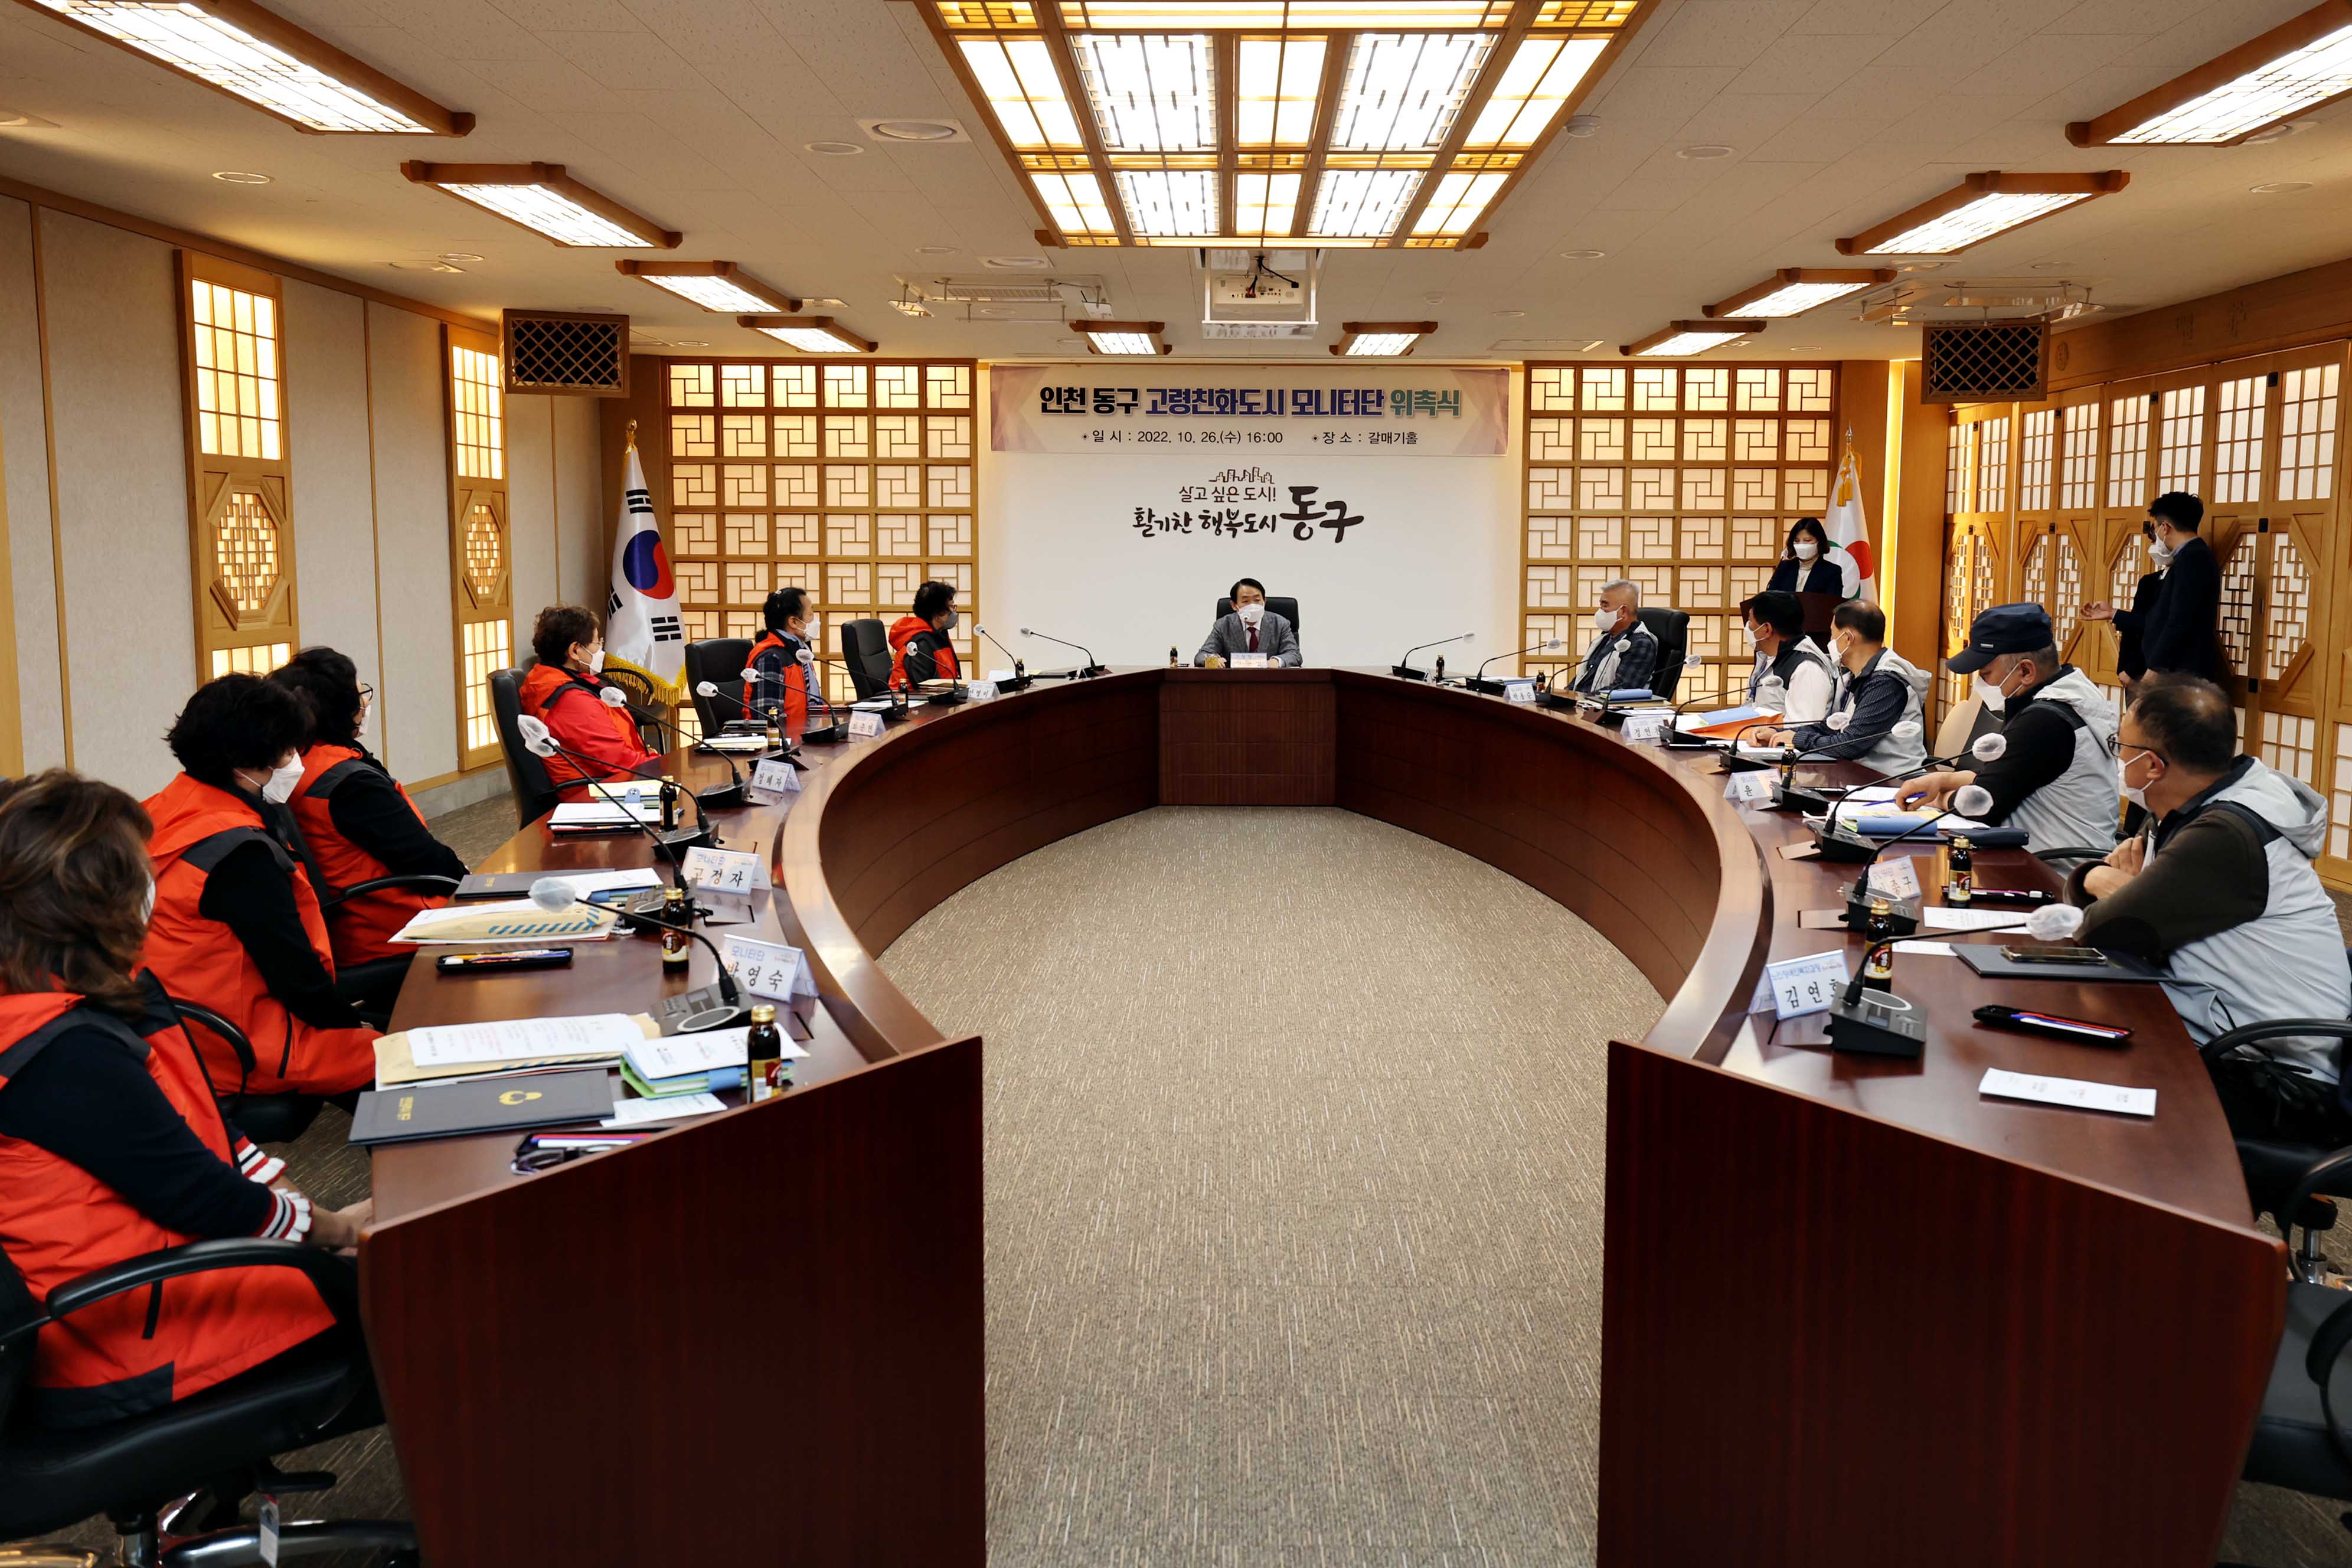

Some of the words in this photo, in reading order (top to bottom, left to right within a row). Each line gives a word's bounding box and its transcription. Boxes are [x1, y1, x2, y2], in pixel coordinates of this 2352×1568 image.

[1040, 387, 1087, 414] 인천
[1093, 387, 1139, 414] 동구
[1145, 388, 1285, 416] 고령친화도시
[1291, 388, 1384, 416] 모니터단
[1390, 389, 1461, 416] 위촉식
[1137, 432, 1172, 443] 2022.
[1177, 432, 1196, 443] 10.
[1200, 430, 1242, 445] 26.(수)
[1247, 432, 1283, 443] 16:00
[1368, 432, 1419, 445] 갈매기홀
[1179, 486, 1208, 502] 살고
[1211, 486, 1240, 503] 싶은
[1243, 486, 1276, 502] 도시!
[1132, 507, 1193, 538] 활기찬
[1198, 508, 1276, 538] 행복도시
[1279, 486, 1364, 543] 동구
